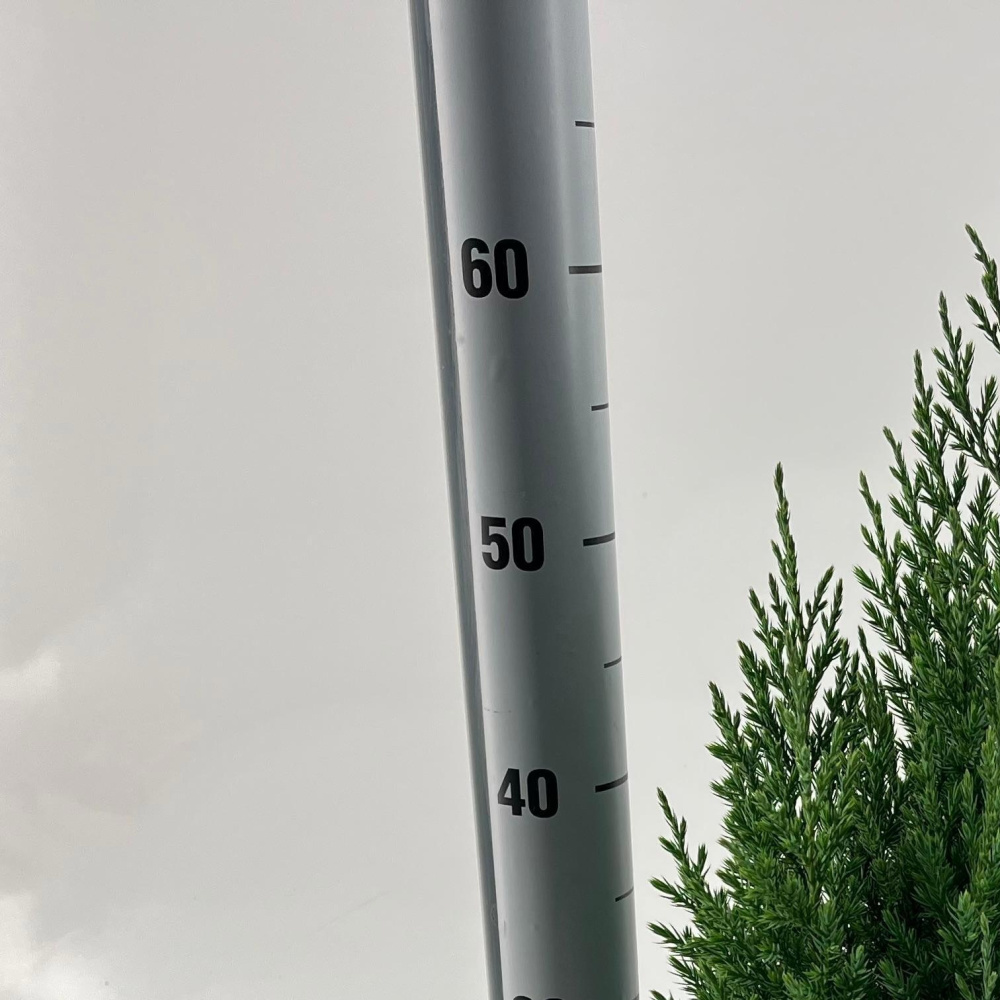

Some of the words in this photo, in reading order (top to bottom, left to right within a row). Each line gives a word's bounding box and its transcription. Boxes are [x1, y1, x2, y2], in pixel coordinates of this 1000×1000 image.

[462, 237, 529, 299] 60
[480, 515, 543, 571] 50
[498, 767, 559, 819] 40
